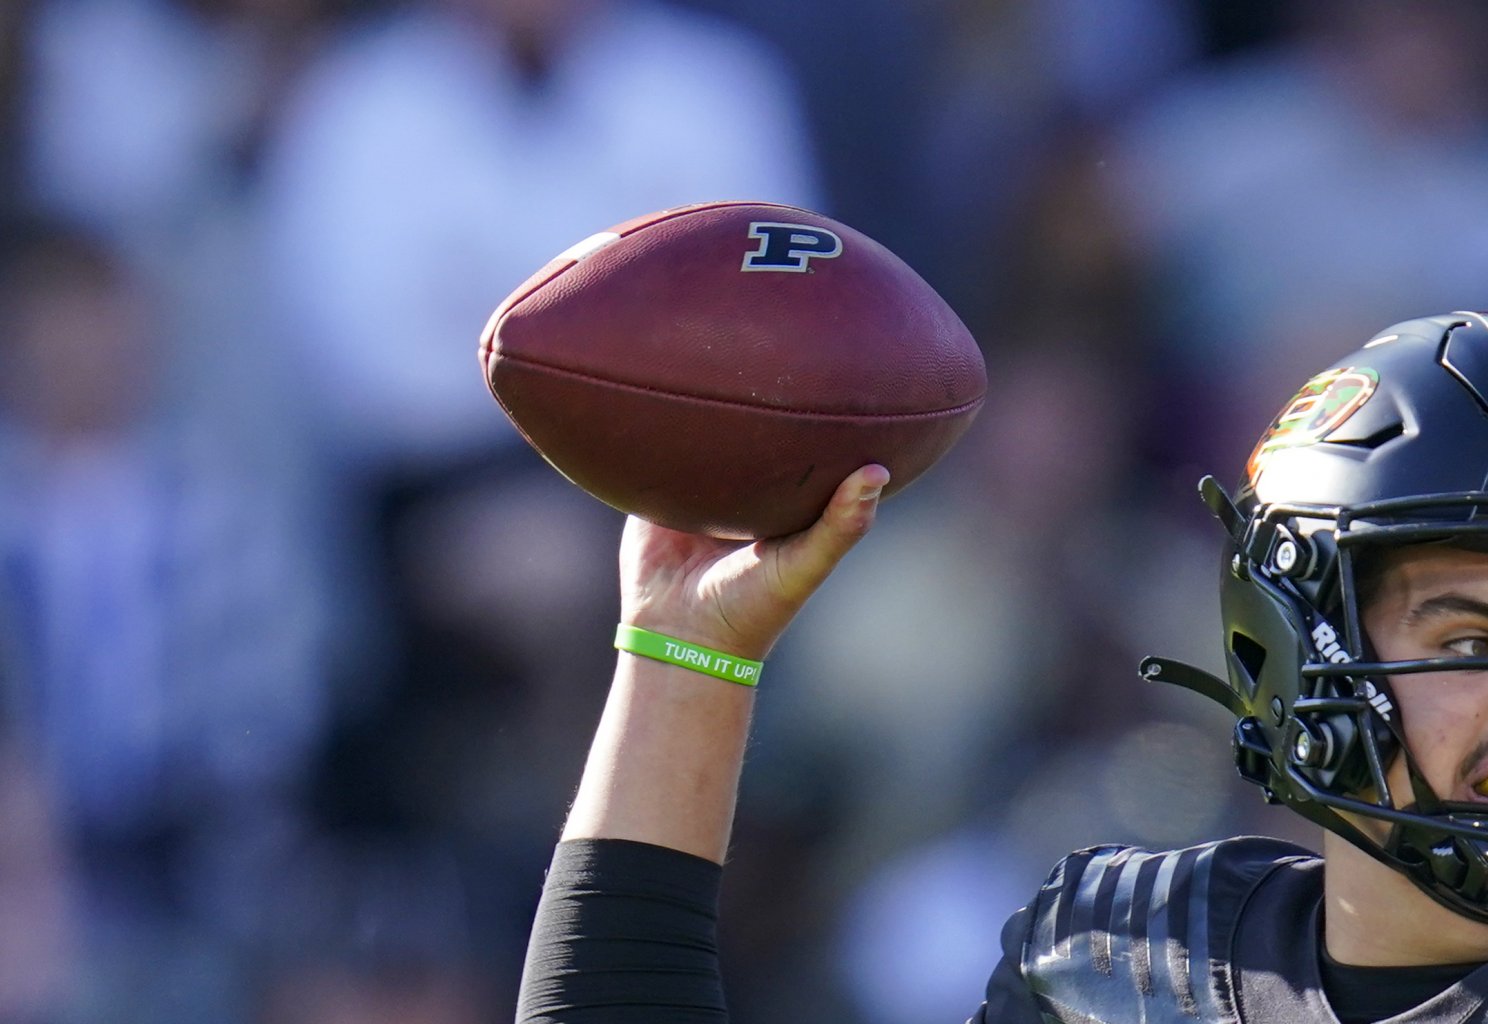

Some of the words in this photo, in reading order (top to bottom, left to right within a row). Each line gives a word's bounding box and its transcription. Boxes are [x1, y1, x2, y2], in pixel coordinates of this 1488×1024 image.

[741, 222, 843, 273] P
[664, 641, 711, 669] TURN
[713, 657, 732, 674] IT
[733, 663, 757, 681] UP!
